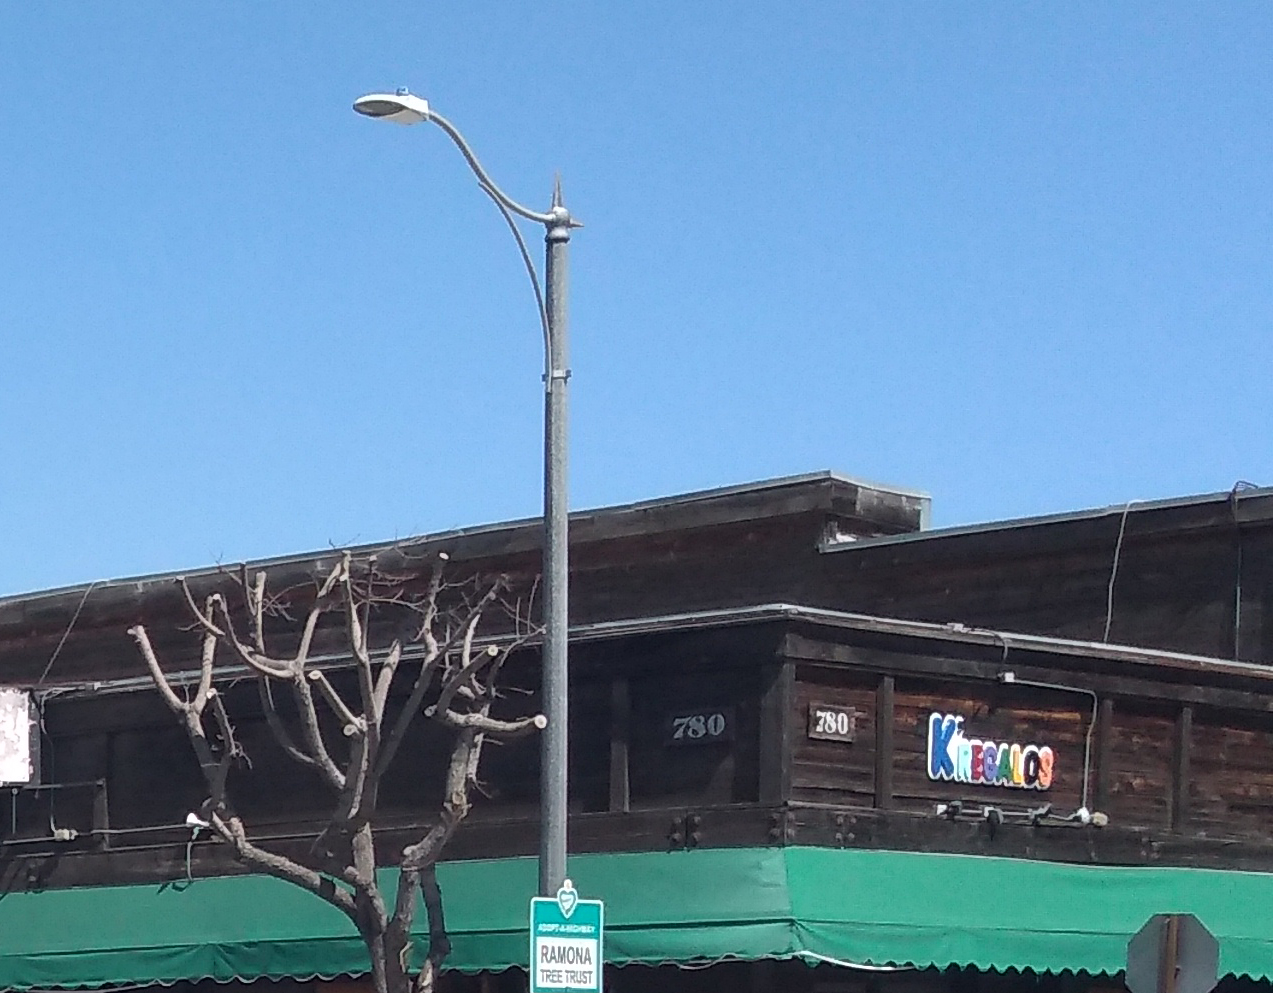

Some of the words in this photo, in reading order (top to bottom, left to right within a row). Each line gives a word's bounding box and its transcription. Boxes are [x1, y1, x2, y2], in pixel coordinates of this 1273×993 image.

[673, 714, 725, 739] 780
[816, 711, 850, 735] 780
[540, 944, 592, 965] RAMONA
[540, 969, 563, 984] TREE
[565, 970, 593, 985] TRUST
